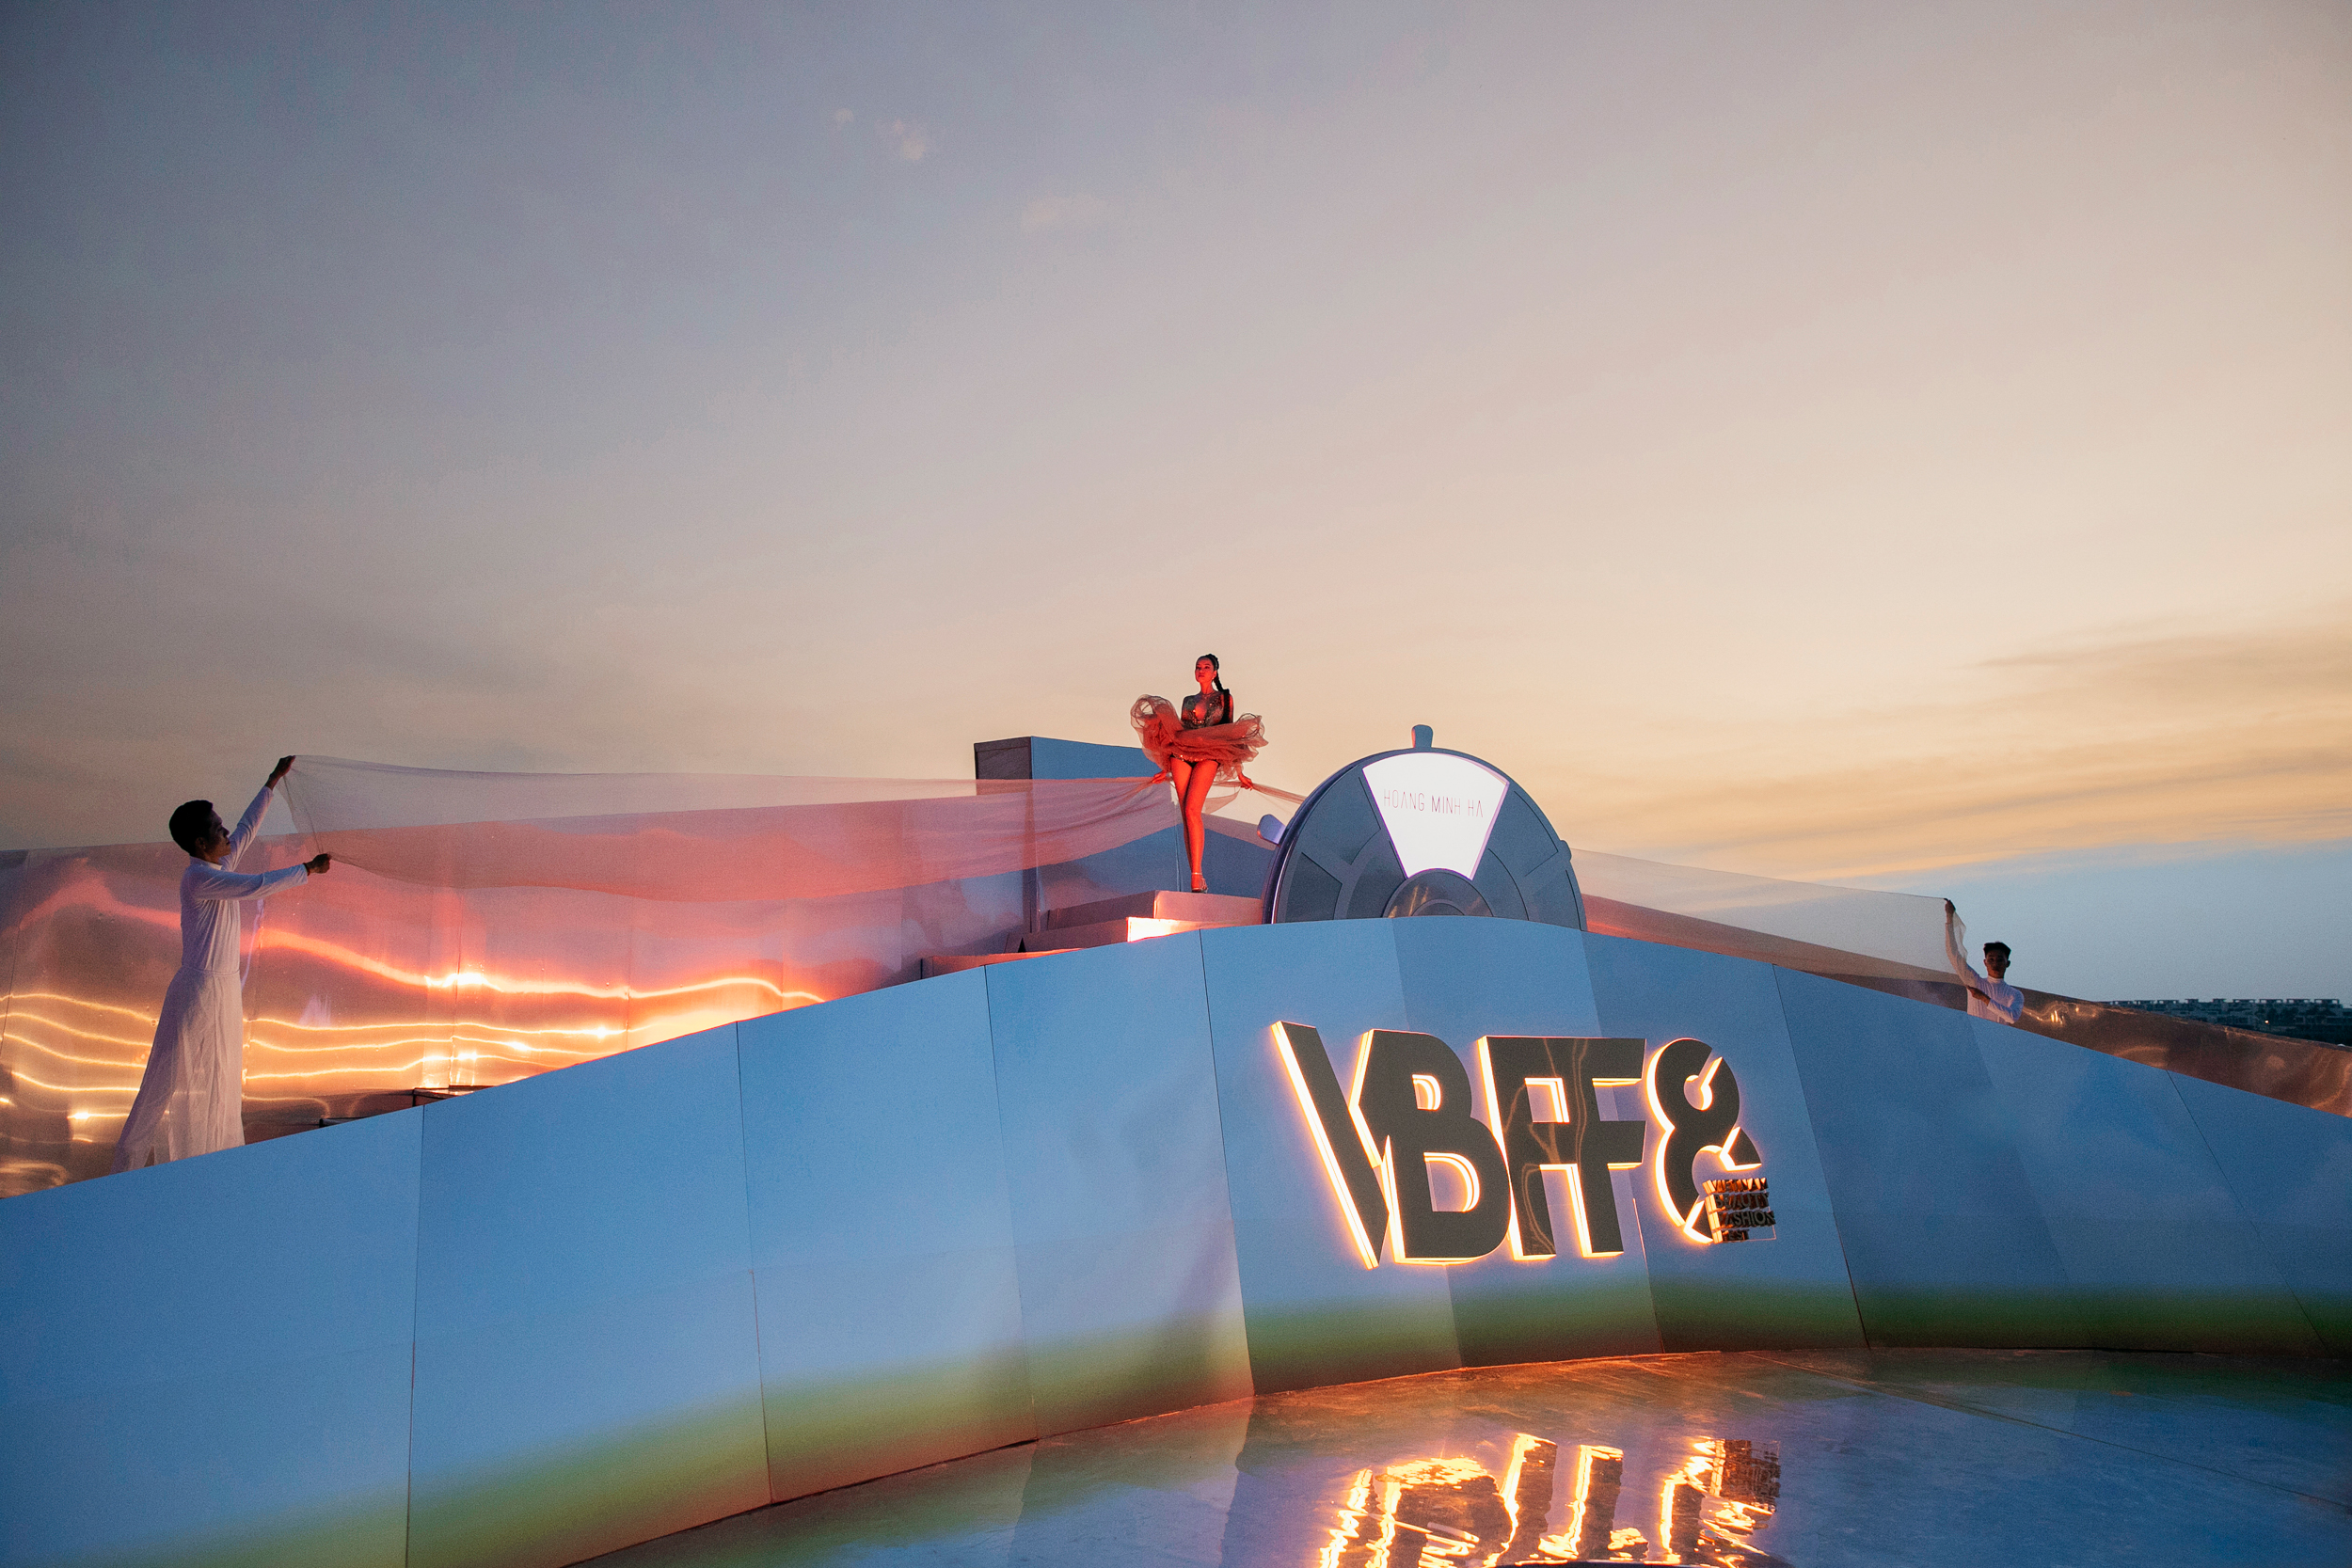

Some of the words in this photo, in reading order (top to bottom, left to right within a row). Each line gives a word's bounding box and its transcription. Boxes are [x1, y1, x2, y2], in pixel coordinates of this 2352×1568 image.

[1383, 788, 1425, 812] HOANG
[1431, 795, 1461, 816] MINH
[1467, 799, 1484, 818] HA
[1708, 1192, 1770, 1212] BEAUTY
[1712, 1210, 1776, 1228] FASHION
